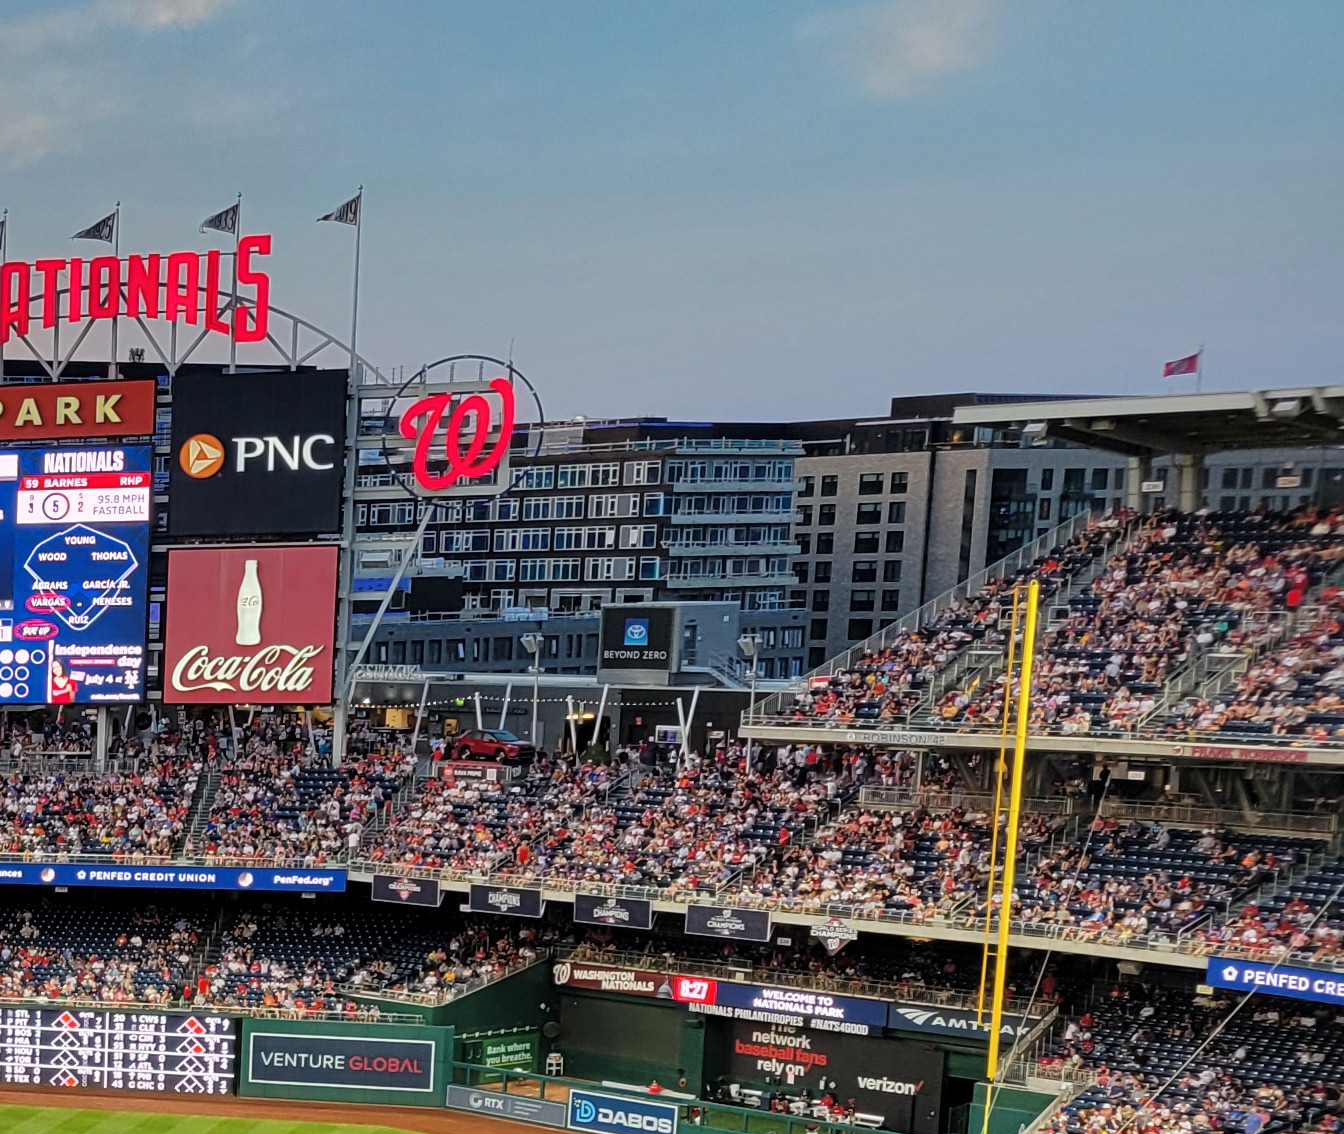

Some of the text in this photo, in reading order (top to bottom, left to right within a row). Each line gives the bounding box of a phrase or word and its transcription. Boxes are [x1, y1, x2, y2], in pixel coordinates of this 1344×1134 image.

[232, 434, 334, 473] PNC
[44, 451, 125, 474] NATIONALS
[25, 476, 143, 488] 59 BARNES RHP
[98, 494, 145, 503] 95.8 MPH
[93, 505, 145, 515] FASTBALL
[65, 536, 96, 545] YOUNG
[38, 552, 128, 561] WOOD THOMAS
[31, 597, 132, 607] VARGAS MENESES
[68, 616, 89, 624] RUIZ
[55, 644, 142, 656] Independence
[603, 650, 668, 660] BEYOND ZERO
[117, 657, 142, 668] day
[170, 644, 325, 692] Coca-Cola
[90, 871, 216, 883] PENFED CREDIT UNION
[573, 969, 635, 981] WASHINGTON
[1243, 969, 1310, 991] PENFED
[601, 979, 654, 991] NATIONALS
[680, 980, 709, 1000] 8:27
[762, 989, 834, 1007] WELCOME TO
[753, 997, 844, 1019] NATIONALS PARK
[688, 1002, 733, 1018] NATIONALS
[735, 1008, 804, 1027] PHILANTHROPIES
[811, 1018, 869, 1036] #NATS4GOOD
[752, 1031, 811, 1050] network
[487, 1041, 531, 1055] Bank where
[735, 1040, 827, 1067] baseball fans
[260, 1050, 422, 1074] VENTURE GLOBAL
[486, 1052, 533, 1066] you breathe.
[757, 1057, 805, 1077] rely on
[857, 1076, 916, 1095] verizon
[484, 1097, 504, 1110] RTX
[597, 1107, 672, 1134] DABOS
